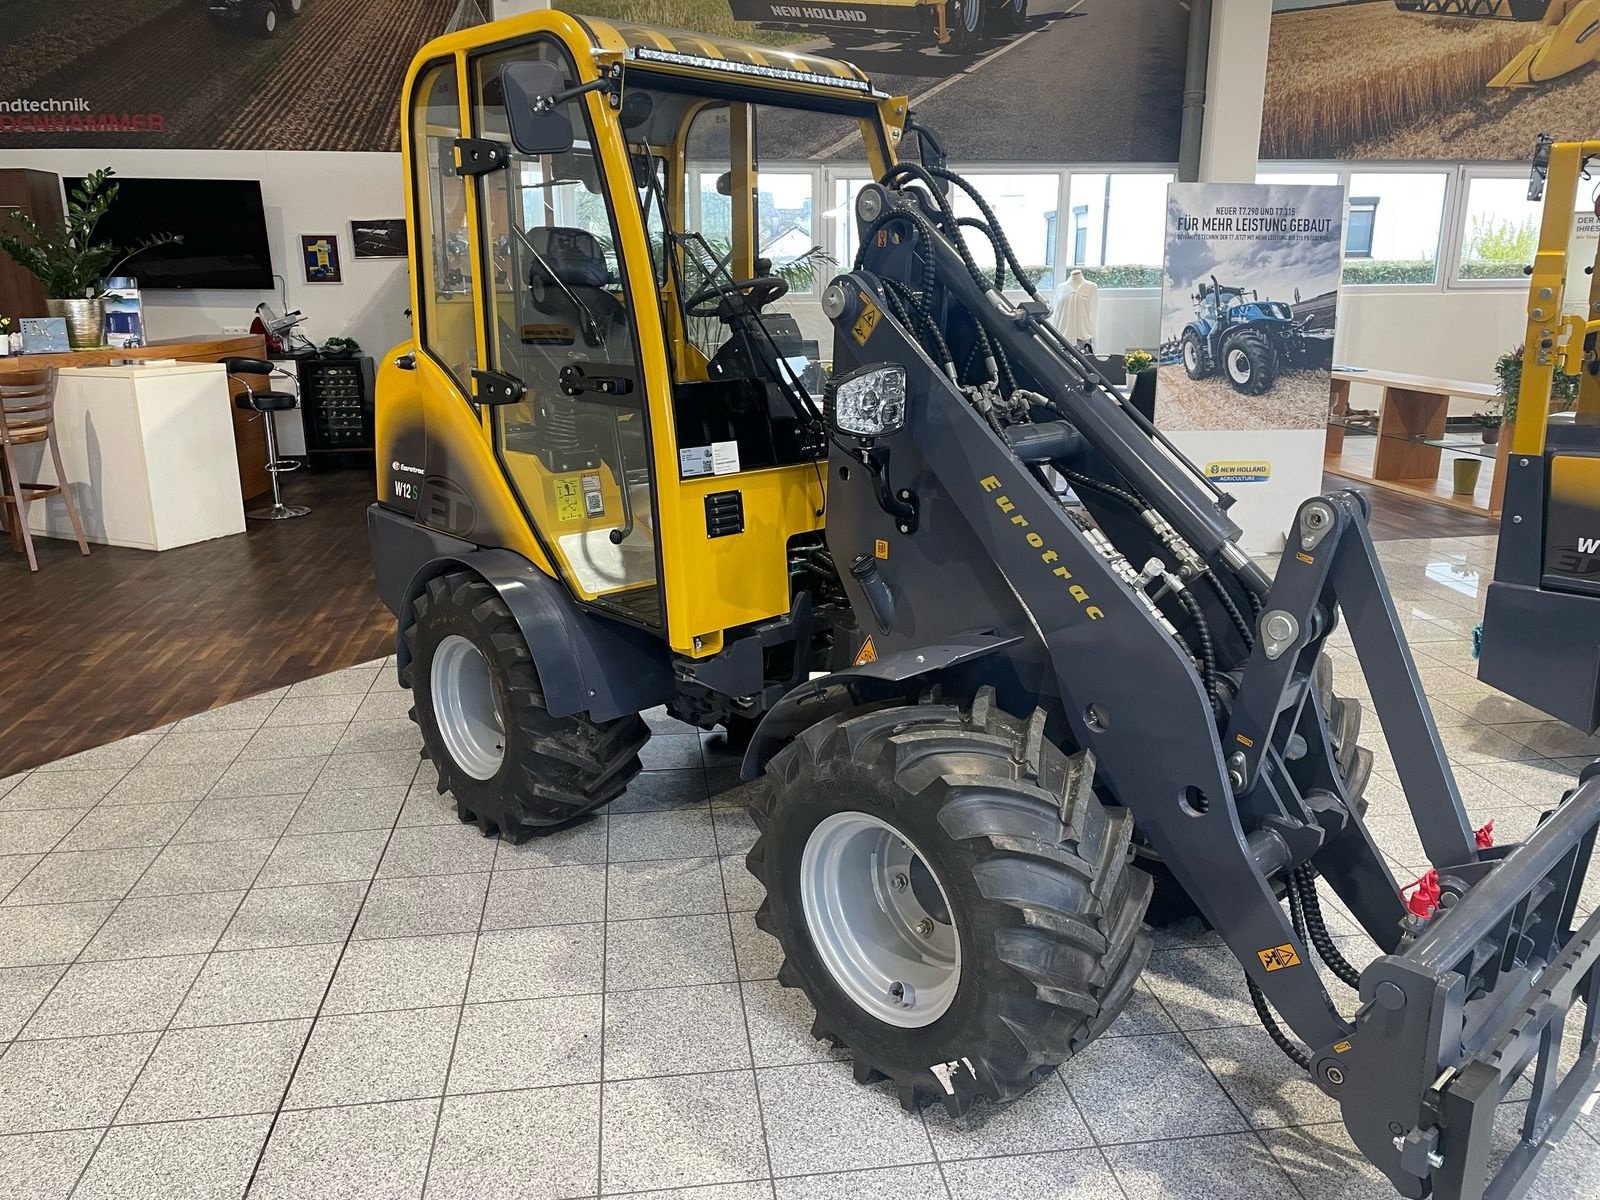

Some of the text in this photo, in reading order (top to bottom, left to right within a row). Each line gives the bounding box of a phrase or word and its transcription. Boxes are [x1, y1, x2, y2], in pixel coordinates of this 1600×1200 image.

[770, 5, 868, 22] NEW HOLLAND
[0, 98, 91, 112] ndtechnik
[1215, 206, 1238, 216] NEUER
[1260, 207, 1274, 216] UND
[1275, 207, 1296, 217] T7.315
[1177, 214, 1332, 233] FÜR MEHR LEISTUNG GEBAUT
[1577, 216, 1595, 224] DER
[979, 474, 1105, 621] Eurotrac
